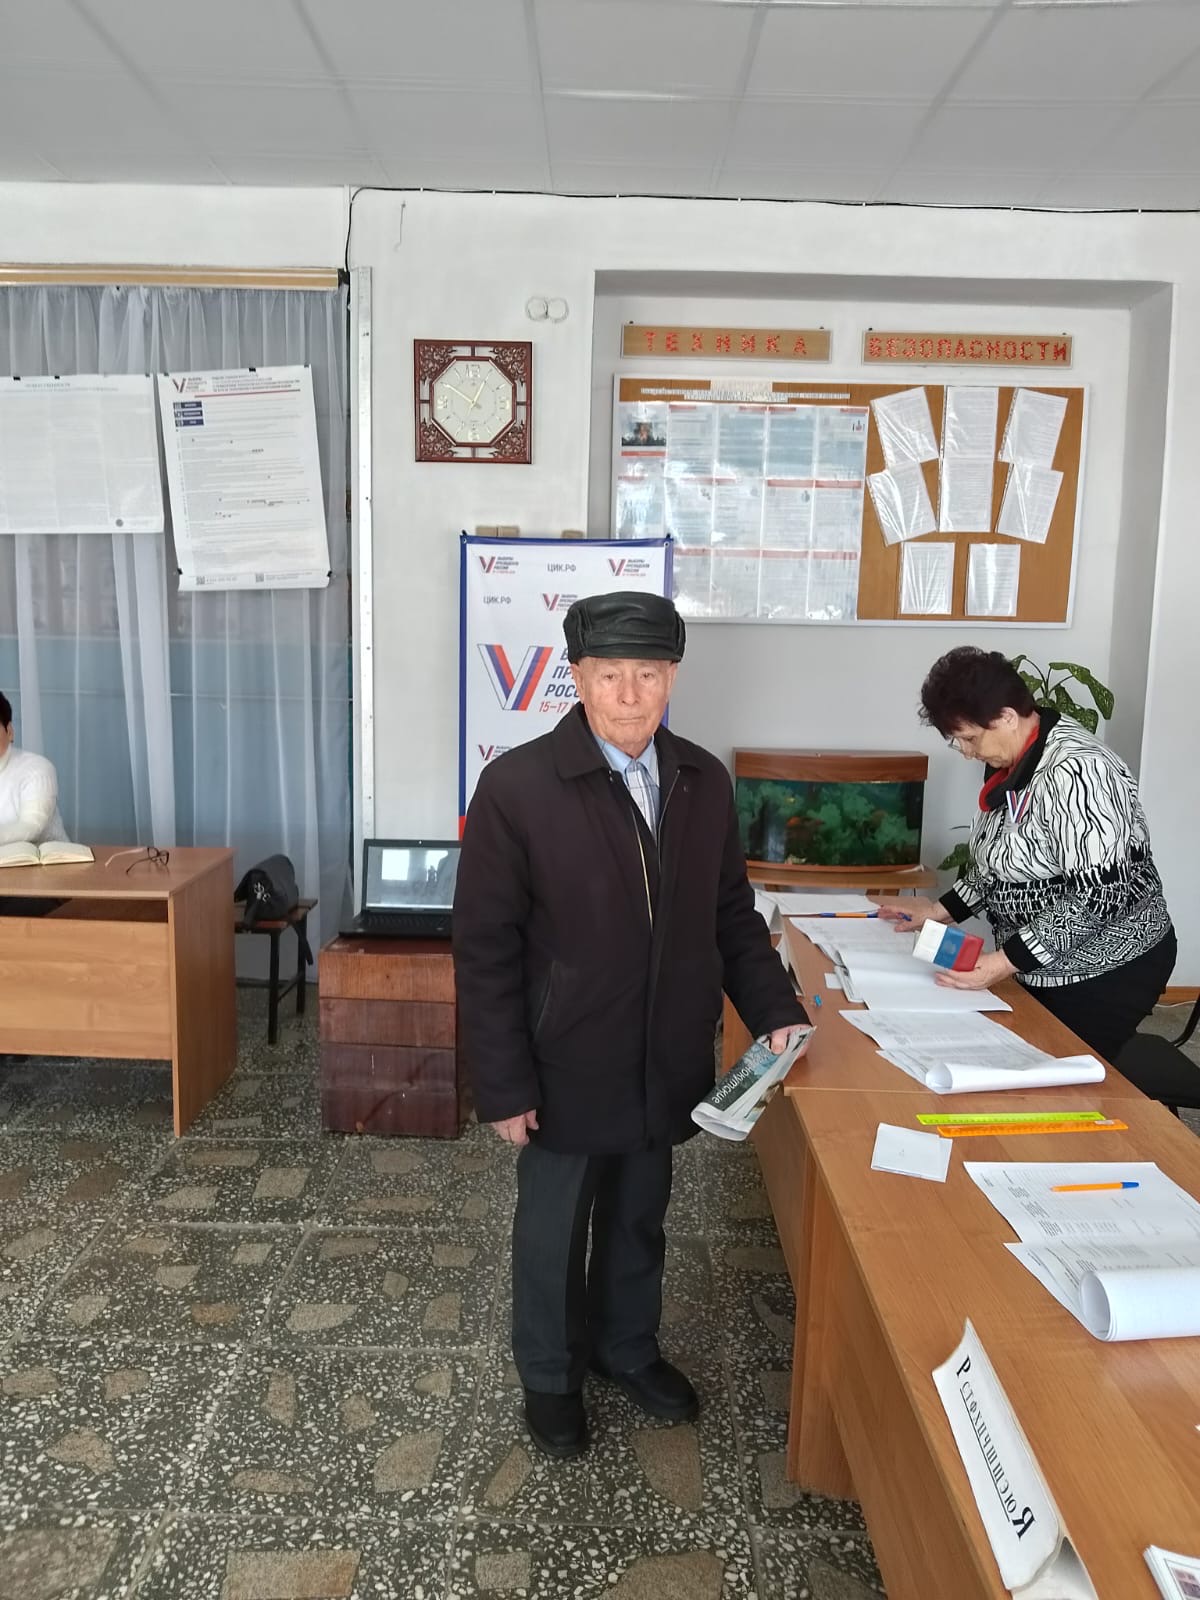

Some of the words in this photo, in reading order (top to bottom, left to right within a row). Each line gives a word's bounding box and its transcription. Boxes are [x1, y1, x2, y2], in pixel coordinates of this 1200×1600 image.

[644, 331, 807, 355] ТЕХНИКА
[868, 337, 1068, 361] БЕЗОПАСНОСТИ
[547, 563, 576, 573] ЦИК.РФ
[483, 595, 511, 605] ЦИК.РФ
[544, 684, 579, 698] РОСС
